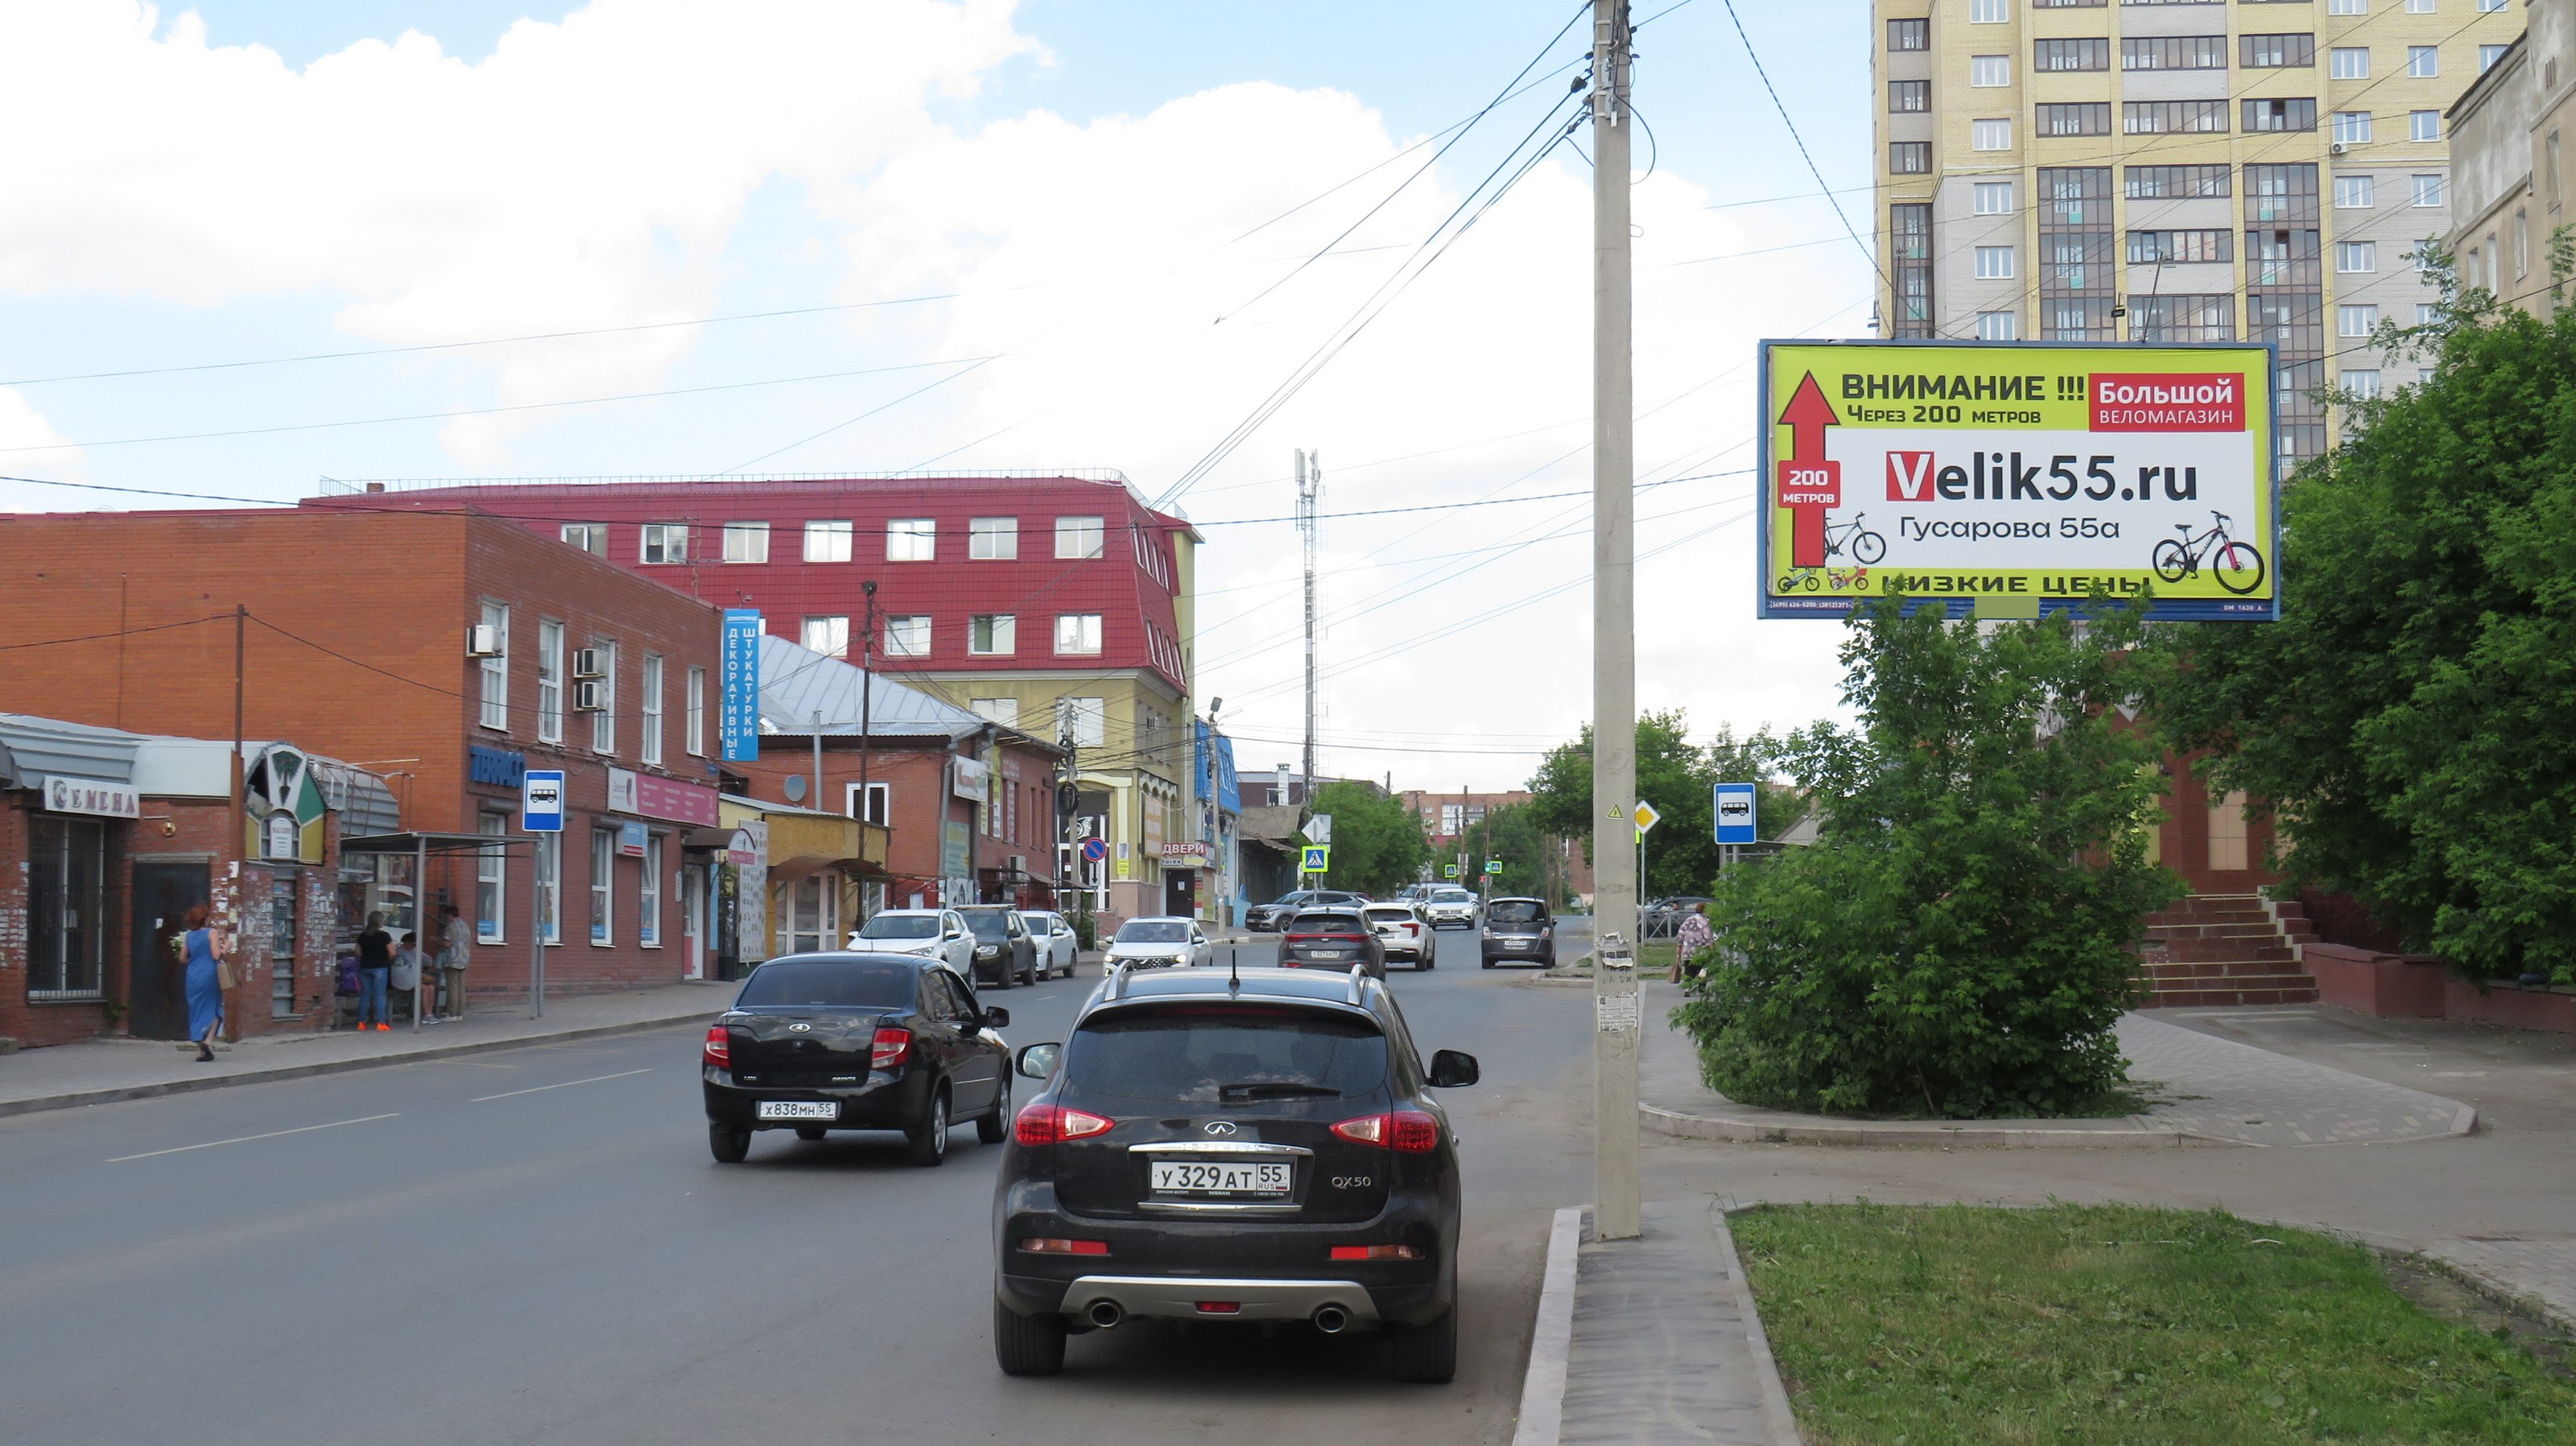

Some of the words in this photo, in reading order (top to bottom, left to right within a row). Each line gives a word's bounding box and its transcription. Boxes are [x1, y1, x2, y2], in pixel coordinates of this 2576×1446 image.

[1842, 374, 2046, 401] ВНИМАНИЕ
[2057, 376, 2084, 401] !!!
[2099, 378, 2233, 404] Большой
[1913, 405, 1961, 423] 200
[2099, 409, 2233, 424] ВЕЛОМАГАЗИН
[1789, 469, 1829, 486] 200
[1888, 451, 2198, 502] Velik55.ru
[1782, 493, 1835, 505] МЕТРОВ
[1900, 516, 2051, 542] Гусарова
[2058, 517, 2120, 539] 55а
[742, 628, 755, 737] ШТУКАТУРКИ
[726, 628, 738, 759] ДЕКОРАТИВНЫЕ
[1162, 845, 1204, 855] ДВЕРИ
[819, 1103, 832, 1113] 55
[1260, 1166, 1282, 1182] 55
[1331, 1176, 1372, 1190] QX50
